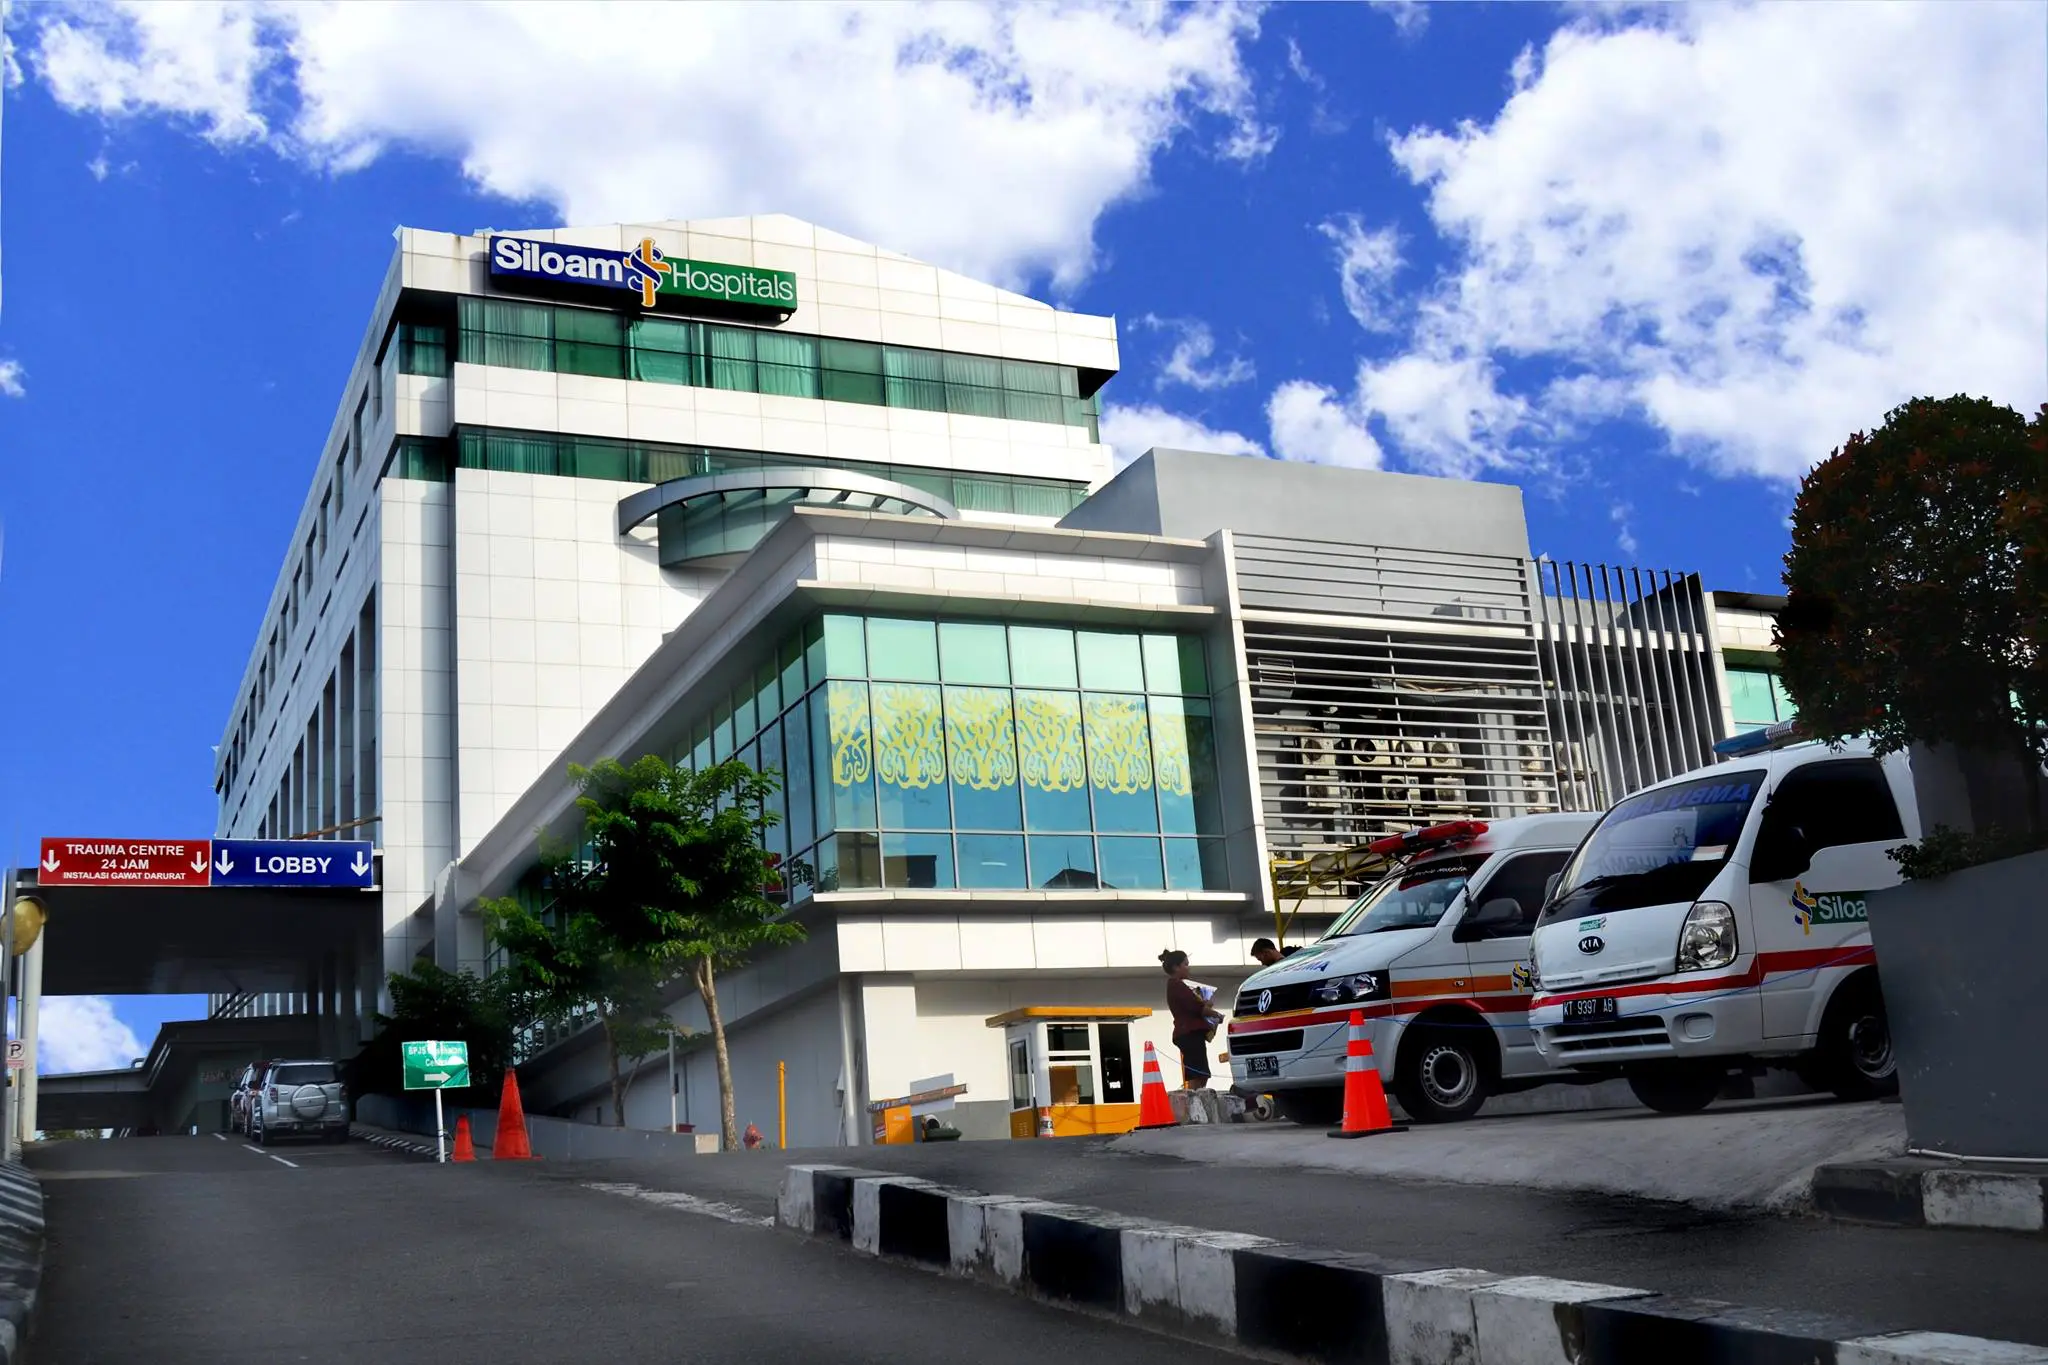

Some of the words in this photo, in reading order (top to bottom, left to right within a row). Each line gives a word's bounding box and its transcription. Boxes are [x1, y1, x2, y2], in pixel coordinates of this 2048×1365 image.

[495, 238, 623, 283] Siloam
[672, 262, 794, 301] Hospitals
[66, 844, 126, 856] TRAUMA
[129, 844, 185, 856] CENTRE
[101, 858, 117, 870] 24
[120, 858, 149, 870] JAM
[254, 856, 332, 874] LOBBY
[63, 871, 109, 880] INSTALASI
[111, 871, 142, 880] GAWAT
[144, 871, 186, 880] DARURAT
[1581, 938, 1599, 951] KIA
[1563, 1000, 1573, 1016] KT
[1577, 999, 1597, 1015] 9397
[1602, 997, 1614, 1013] AB
